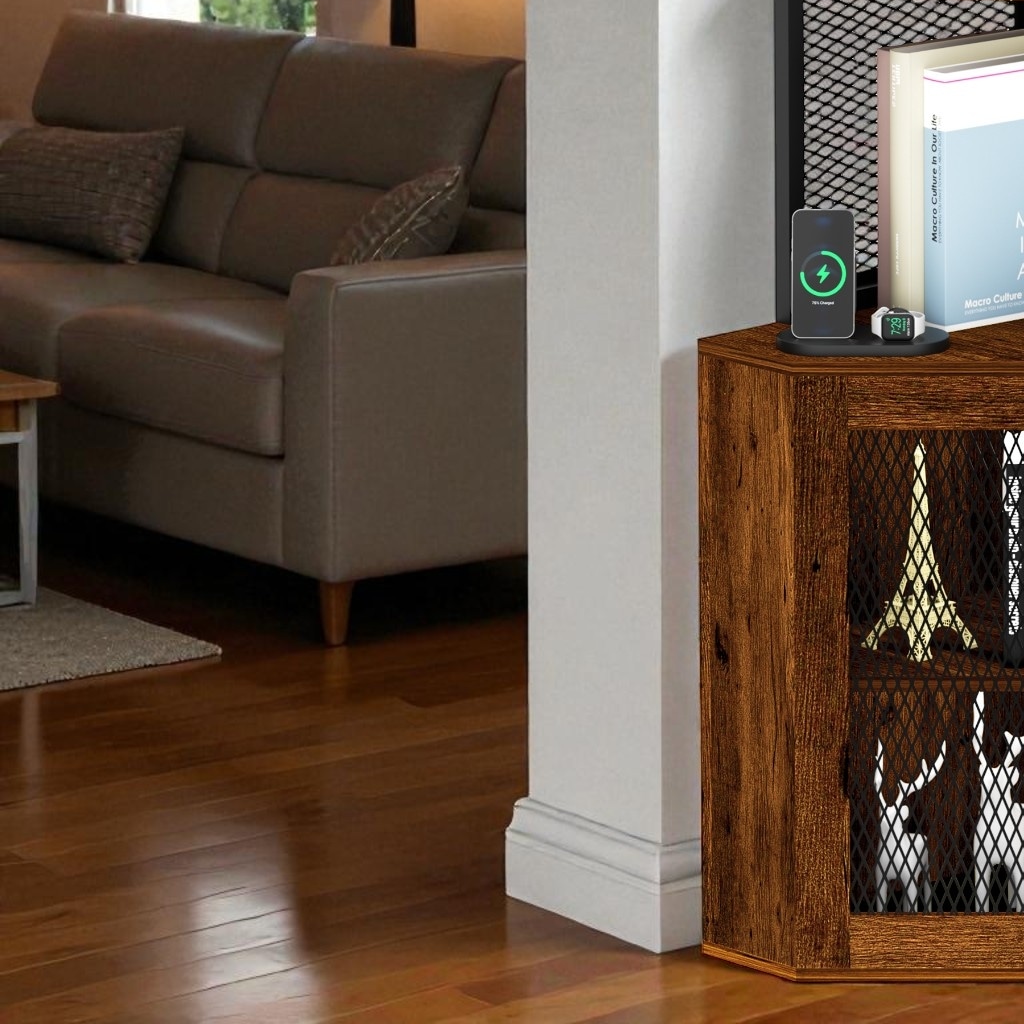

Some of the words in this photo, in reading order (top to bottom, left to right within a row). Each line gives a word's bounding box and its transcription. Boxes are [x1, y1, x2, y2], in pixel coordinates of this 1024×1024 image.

[931, 156, 938, 165] In
[964, 298, 991, 309] Macro
[993, 291, 1022, 304] Culture
[890, 317, 902, 335] 7:29
